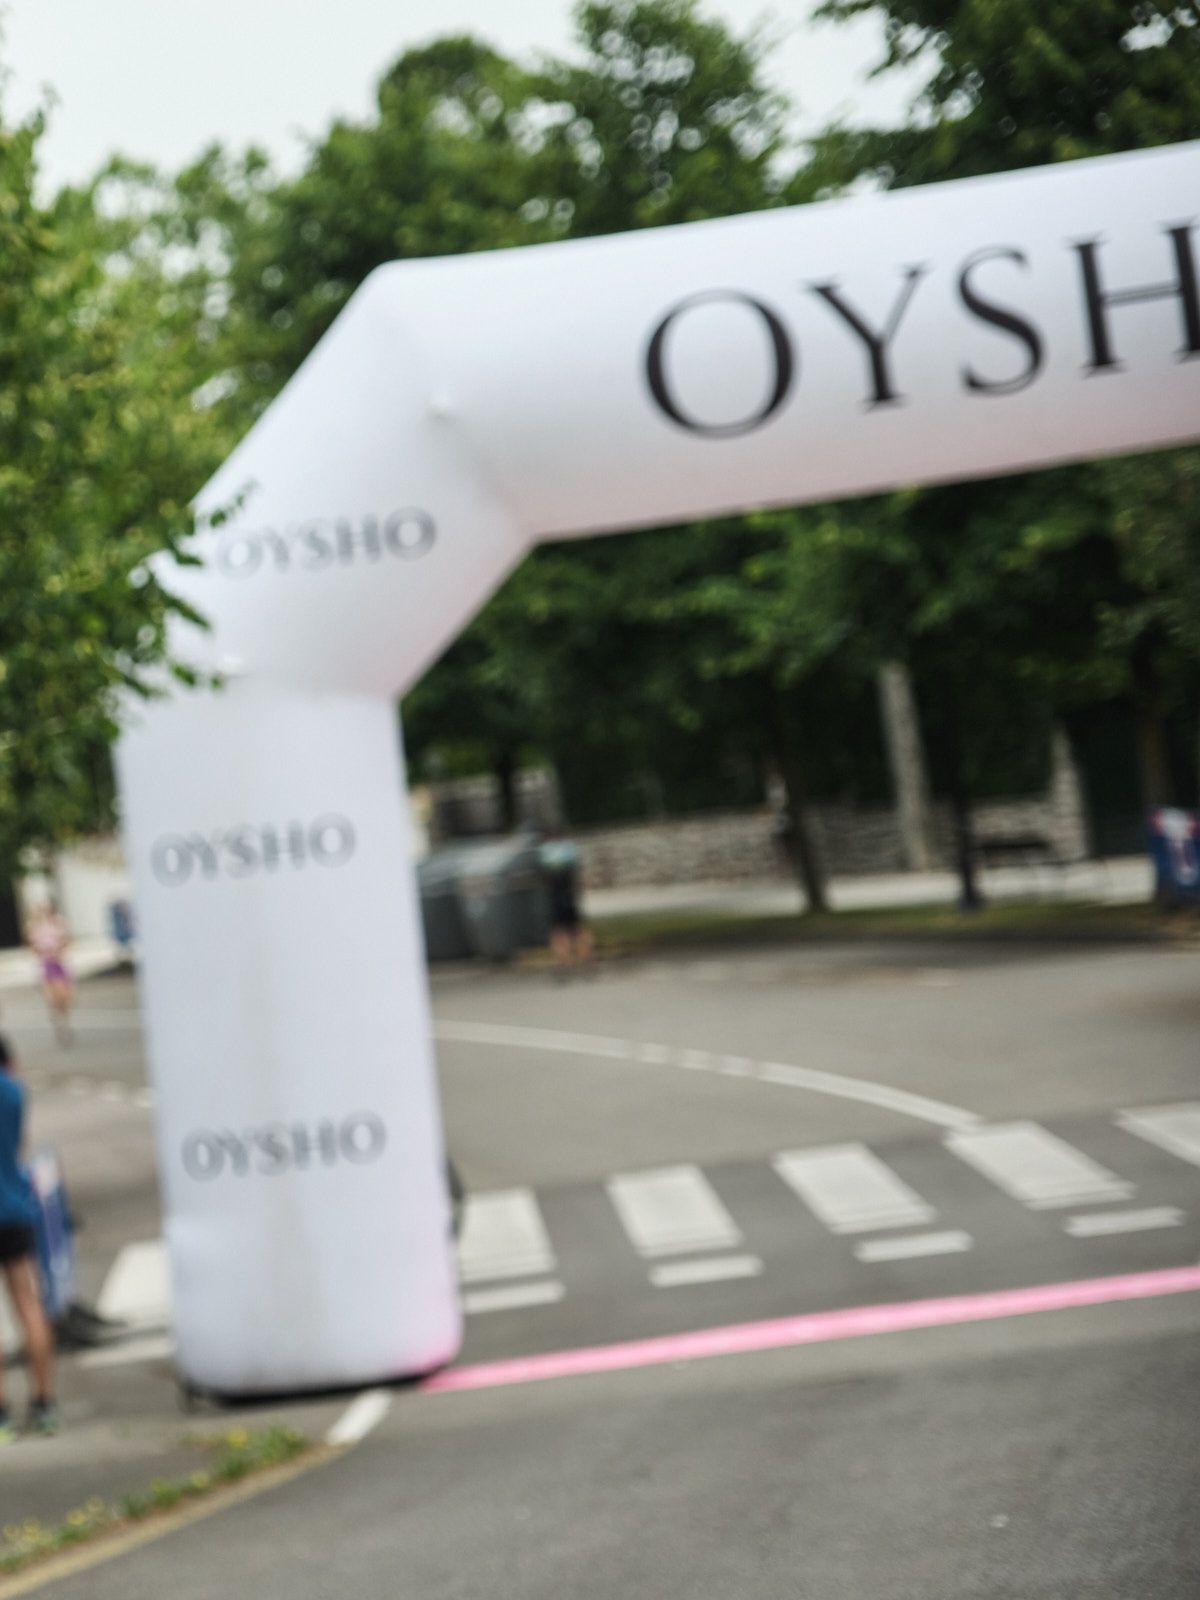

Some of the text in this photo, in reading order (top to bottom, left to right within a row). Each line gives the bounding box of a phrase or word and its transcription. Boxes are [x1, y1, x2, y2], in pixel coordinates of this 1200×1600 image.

[215, 506, 437, 579] OYSHO
[151, 811, 357, 888] OYSHO
[181, 1109, 387, 1184] OYSHO
